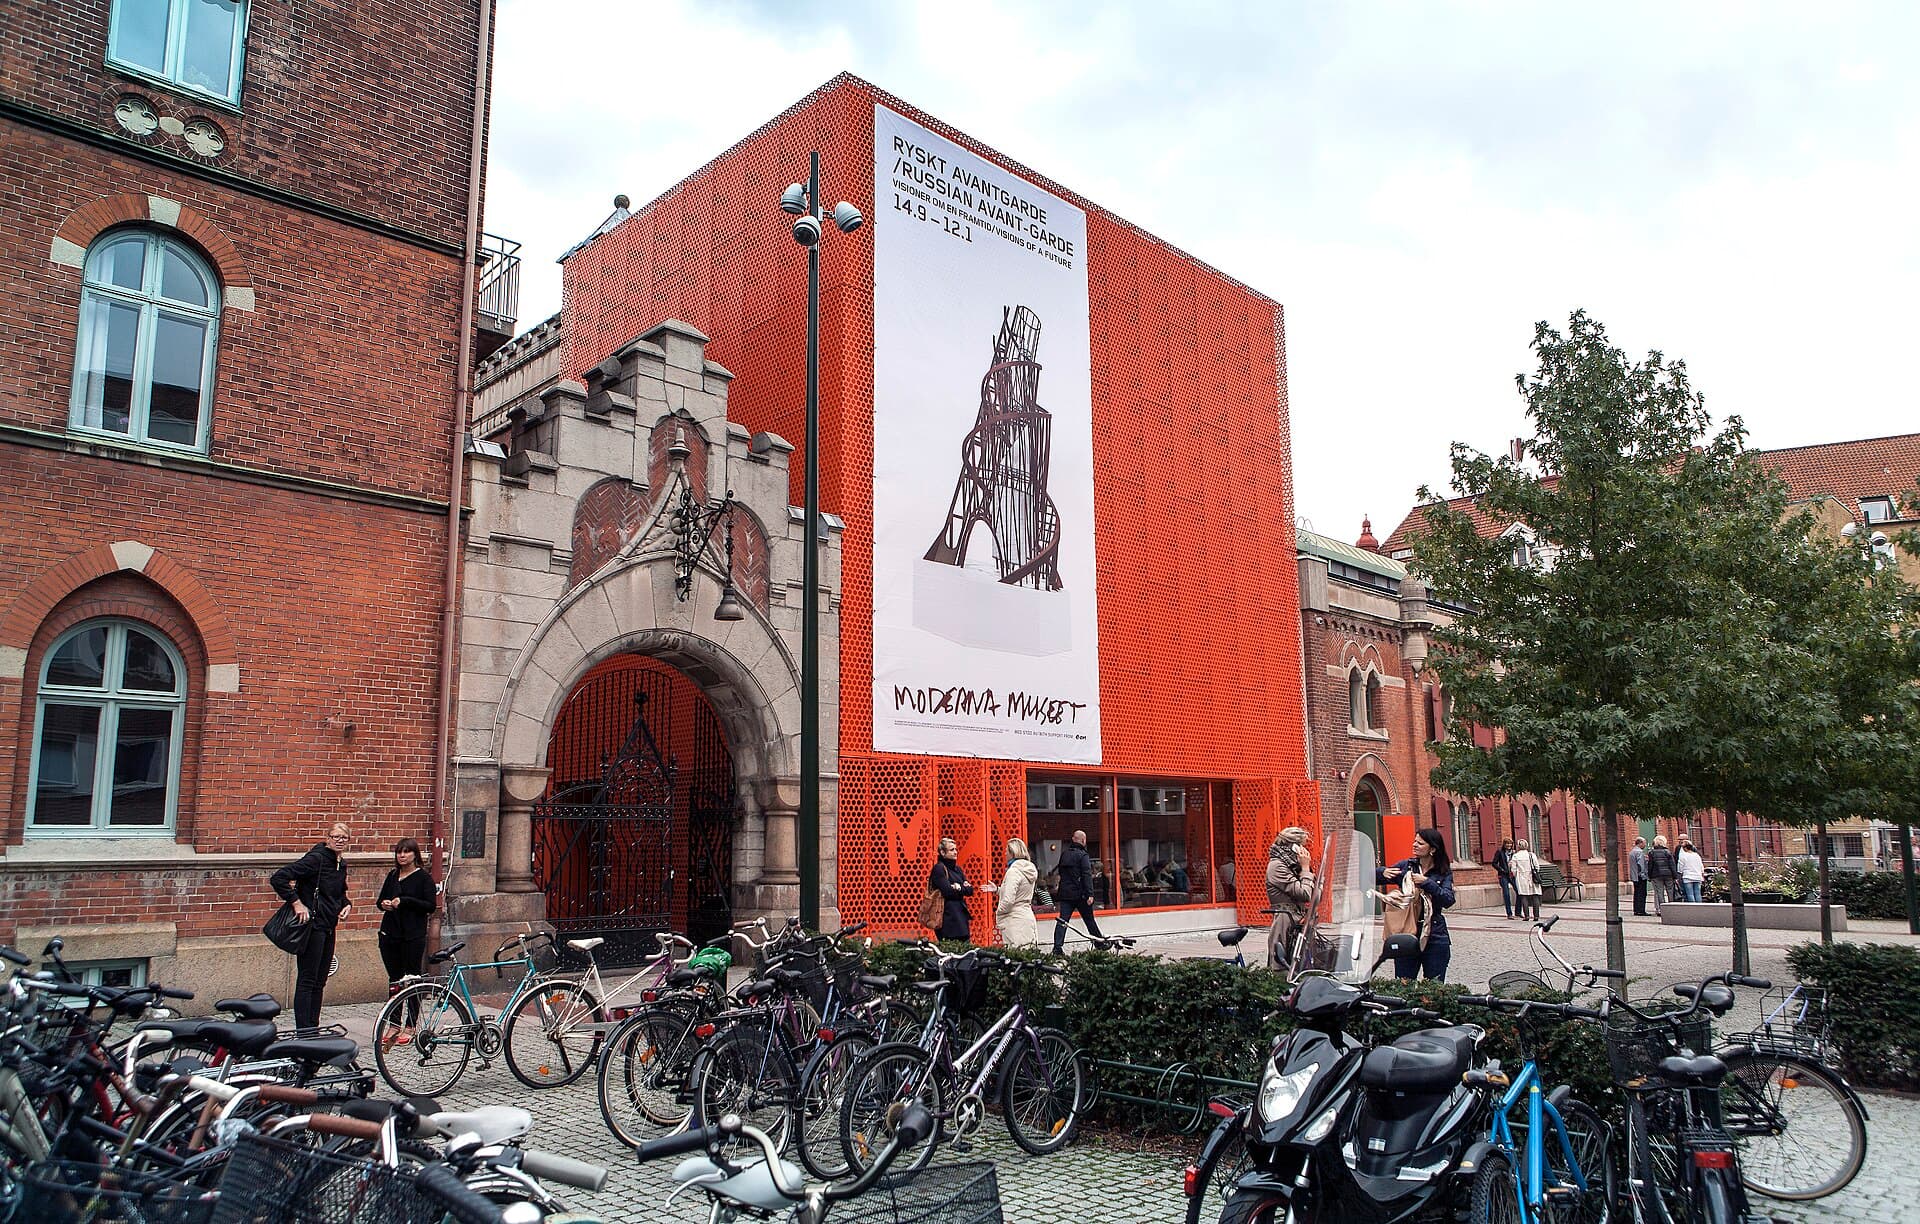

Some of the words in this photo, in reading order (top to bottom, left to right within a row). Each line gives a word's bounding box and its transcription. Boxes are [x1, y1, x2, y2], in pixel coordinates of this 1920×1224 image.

[893, 135, 946, 174] RYSKT
[952, 166, 1047, 225] AVANTGARDE
[893, 157, 972, 208] /RUSSIAN
[978, 199, 1074, 257] AVANT-GARDE
[893, 178, 931, 204] VISIONER
[932, 197, 946, 210] OM
[947, 203, 957, 215] EN
[1026, 241, 1036, 251] OF
[1038, 247, 1043, 256] A
[1044, 250, 1072, 269] FUTURE
[1008, 691, 1087, 725] MUSEET
